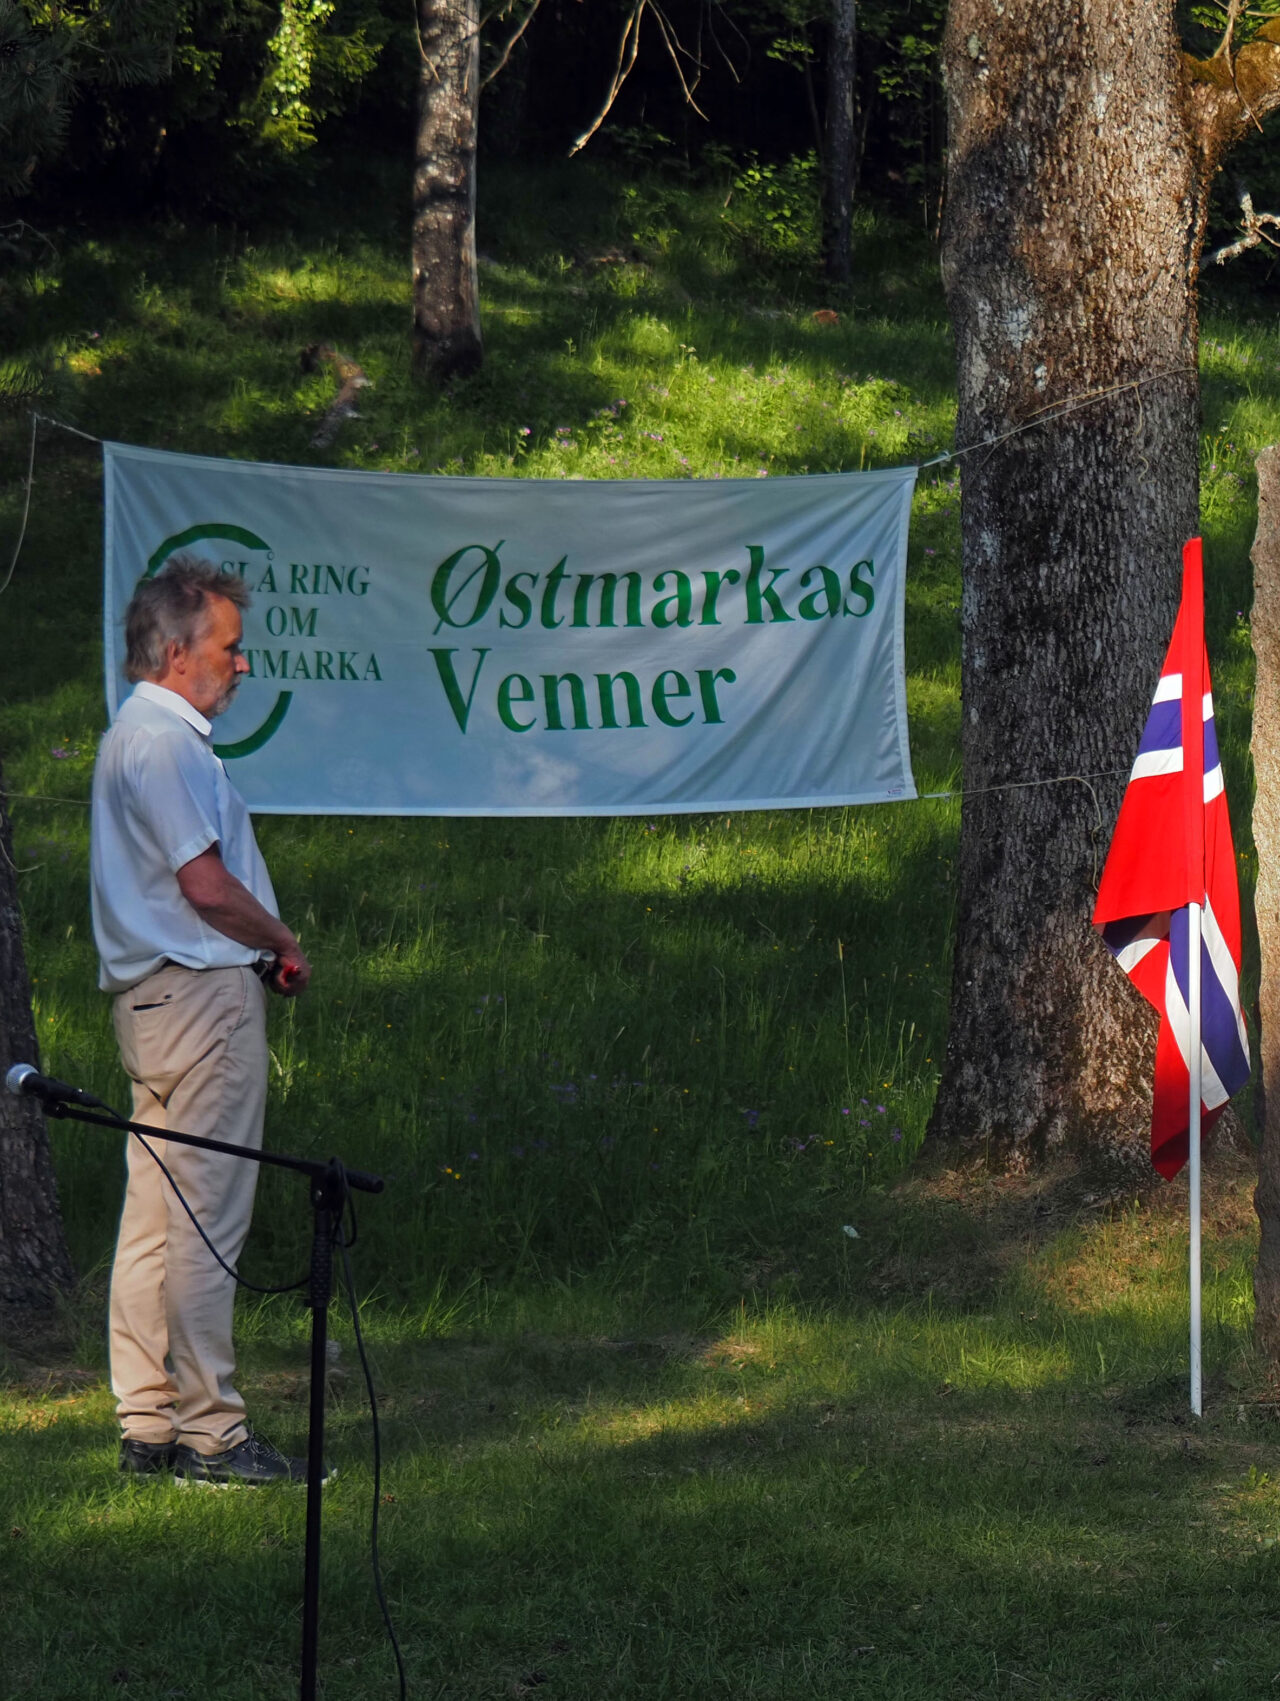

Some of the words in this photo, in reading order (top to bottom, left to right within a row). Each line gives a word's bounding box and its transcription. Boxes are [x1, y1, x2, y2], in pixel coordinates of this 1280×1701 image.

[290, 564, 371, 597] RING
[430, 539, 876, 636] Østmarkas
[265, 605, 320, 638] OM
[426, 647, 737, 736] Venner
